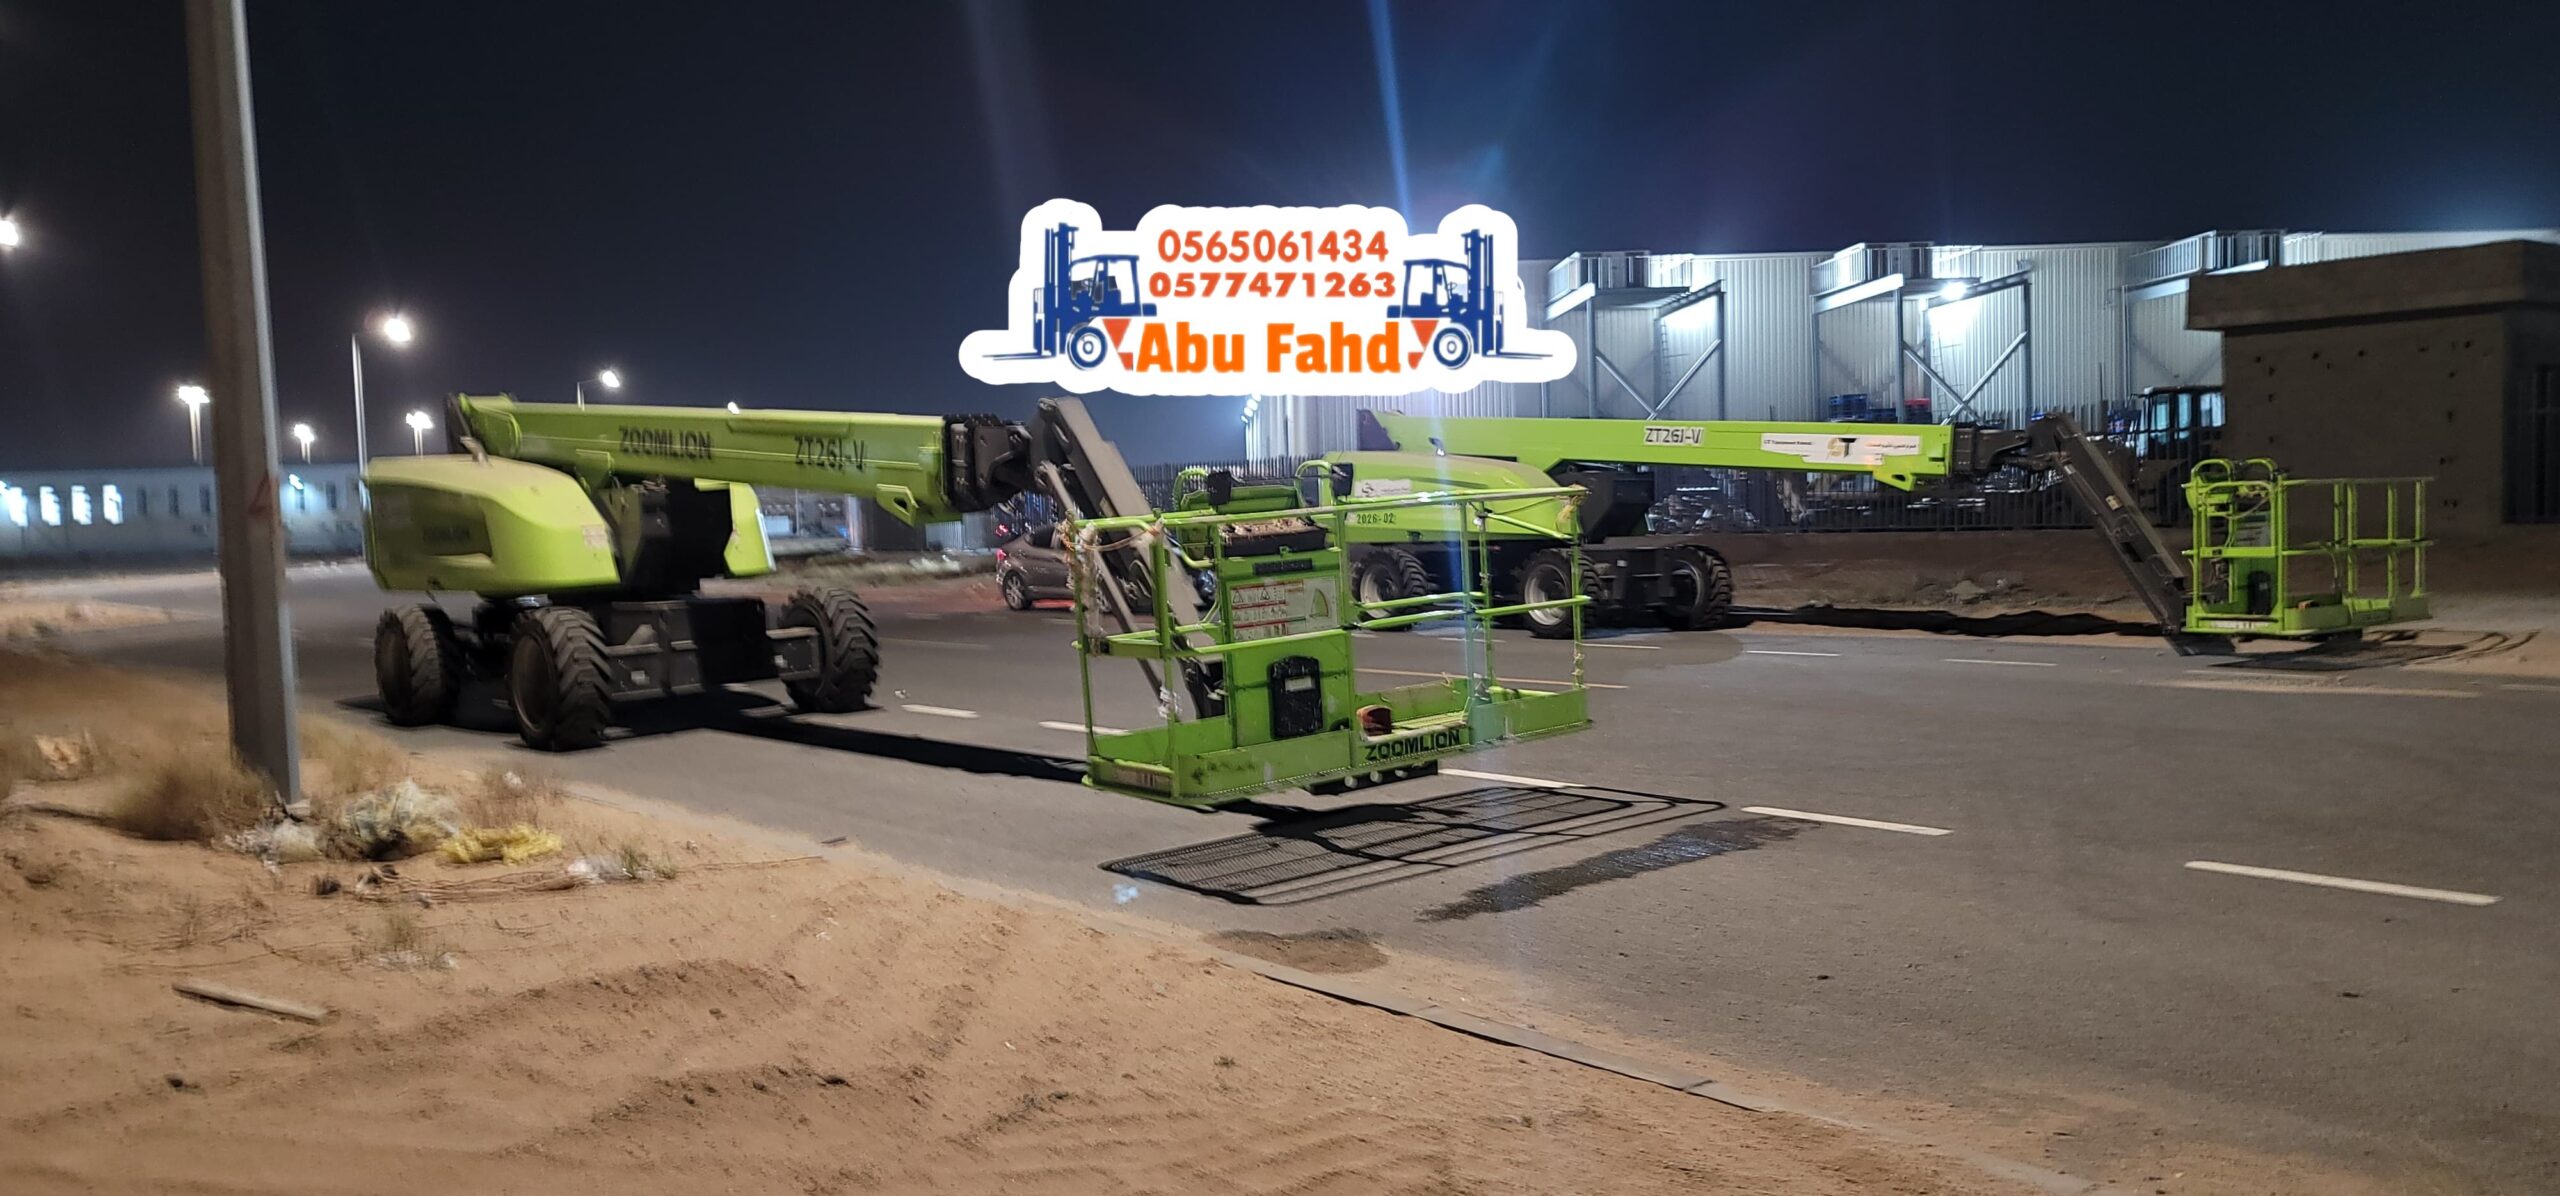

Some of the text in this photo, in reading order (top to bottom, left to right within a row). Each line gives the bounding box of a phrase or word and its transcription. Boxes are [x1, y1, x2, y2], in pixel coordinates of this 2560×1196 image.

[618, 426, 713, 460] ZOOMLION
[1645, 428, 1702, 444] ZT26J-V
[1365, 729, 1461, 761] ZOOMLION
